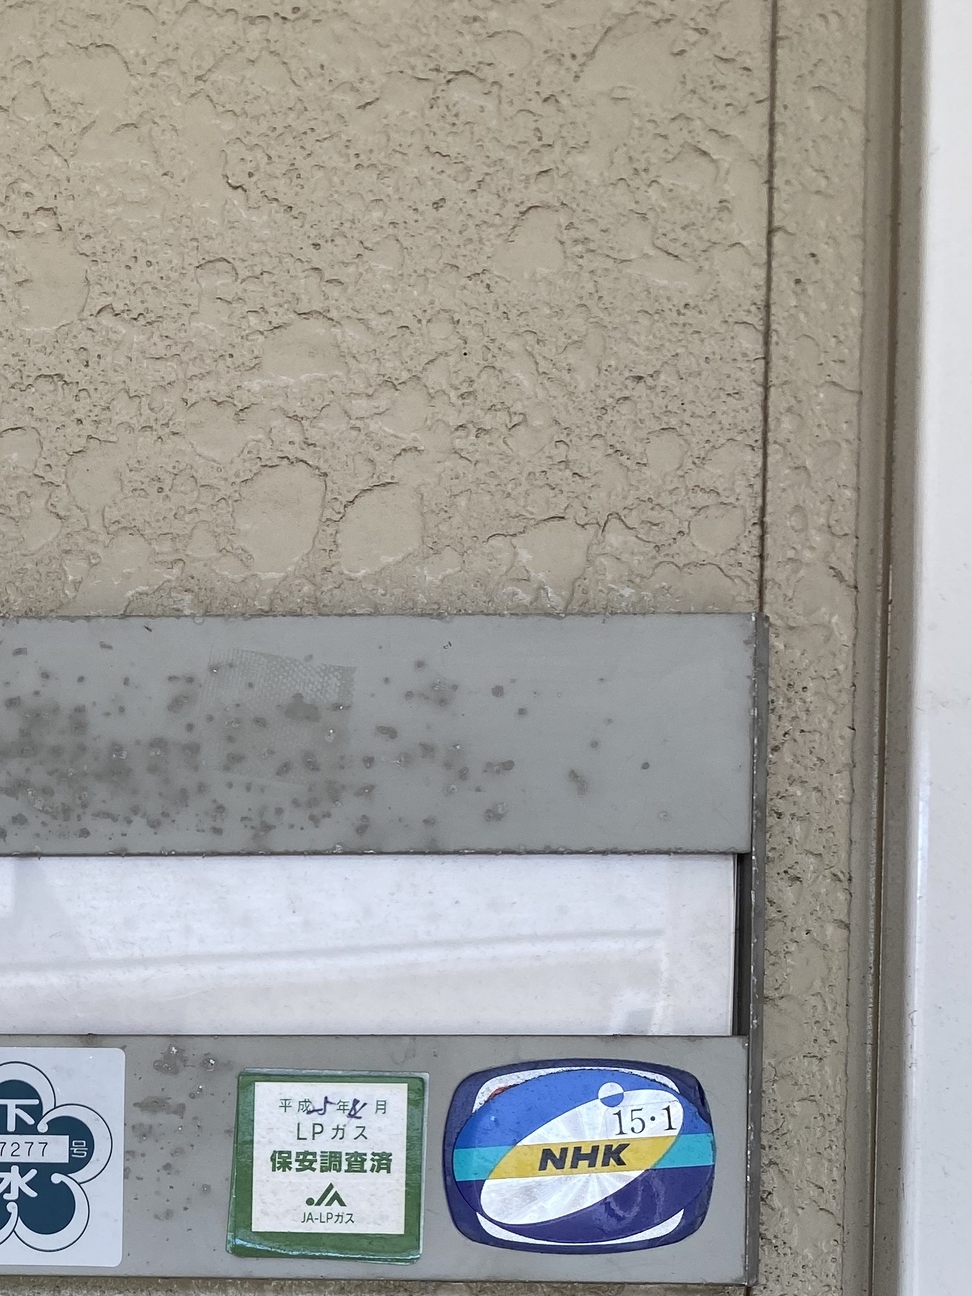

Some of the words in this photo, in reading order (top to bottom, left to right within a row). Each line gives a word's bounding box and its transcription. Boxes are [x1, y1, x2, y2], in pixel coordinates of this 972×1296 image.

[296, 1122, 369, 1141] LPガス
[269, 1149, 393, 1174] 保安調査済
[538, 1142, 630, 1171] NHK
[300, 1212, 355, 1224] JA-LPガス
